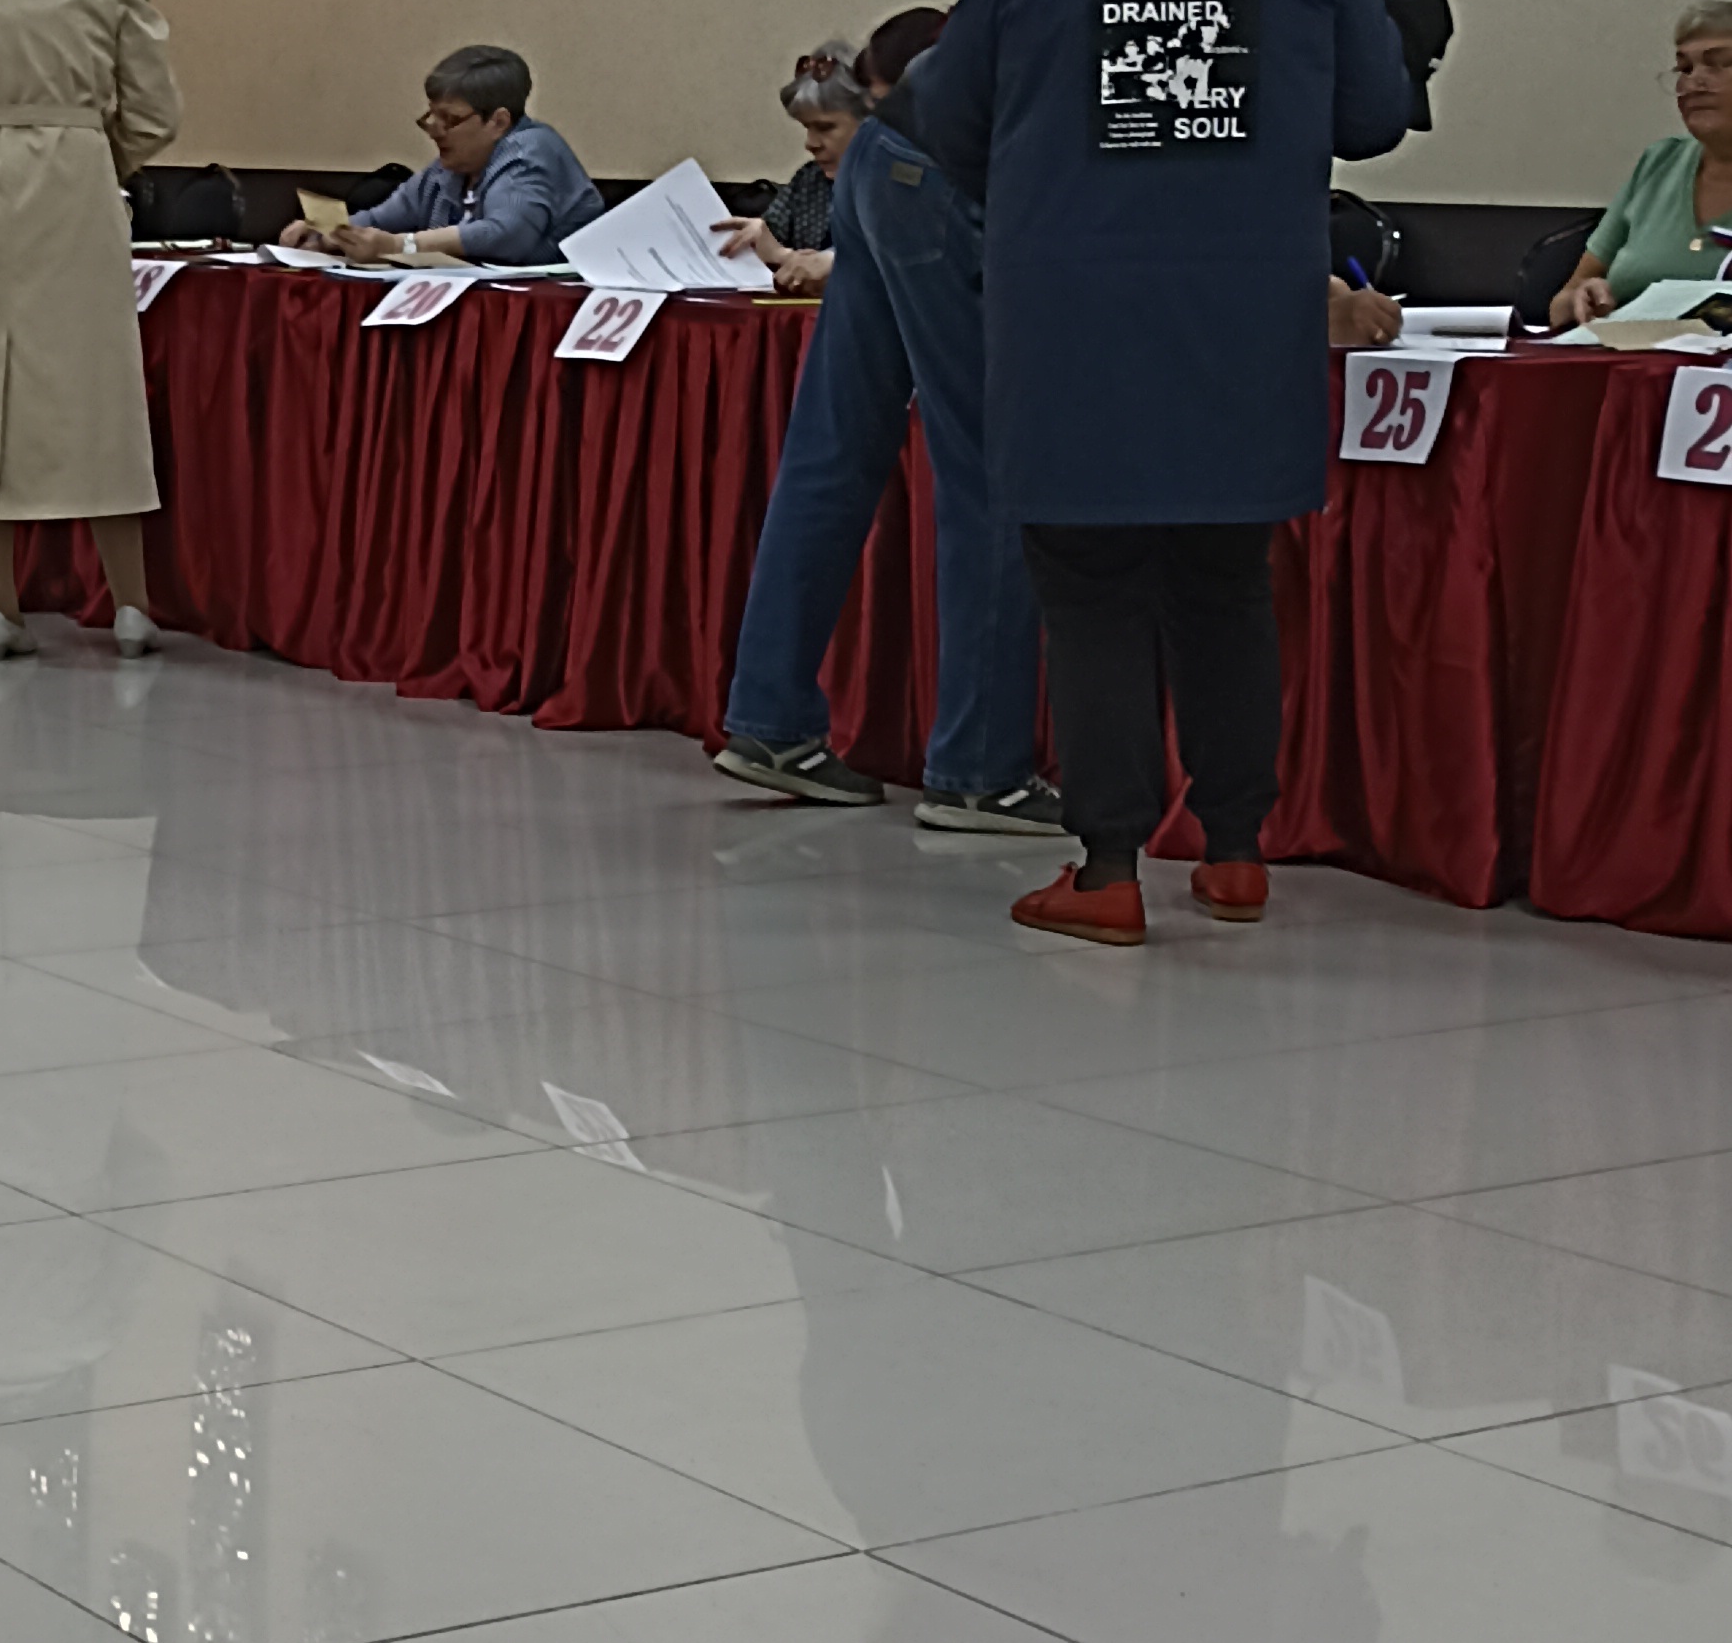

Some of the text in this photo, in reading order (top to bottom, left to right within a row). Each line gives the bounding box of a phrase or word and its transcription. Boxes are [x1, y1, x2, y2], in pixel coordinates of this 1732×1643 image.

[1102, 0, 1223, 24] DRAINED
[1173, 116, 1247, 139] SOUL
[382, 281, 452, 320] 20
[573, 297, 643, 353] 22
[1360, 368, 1431, 451] 25
